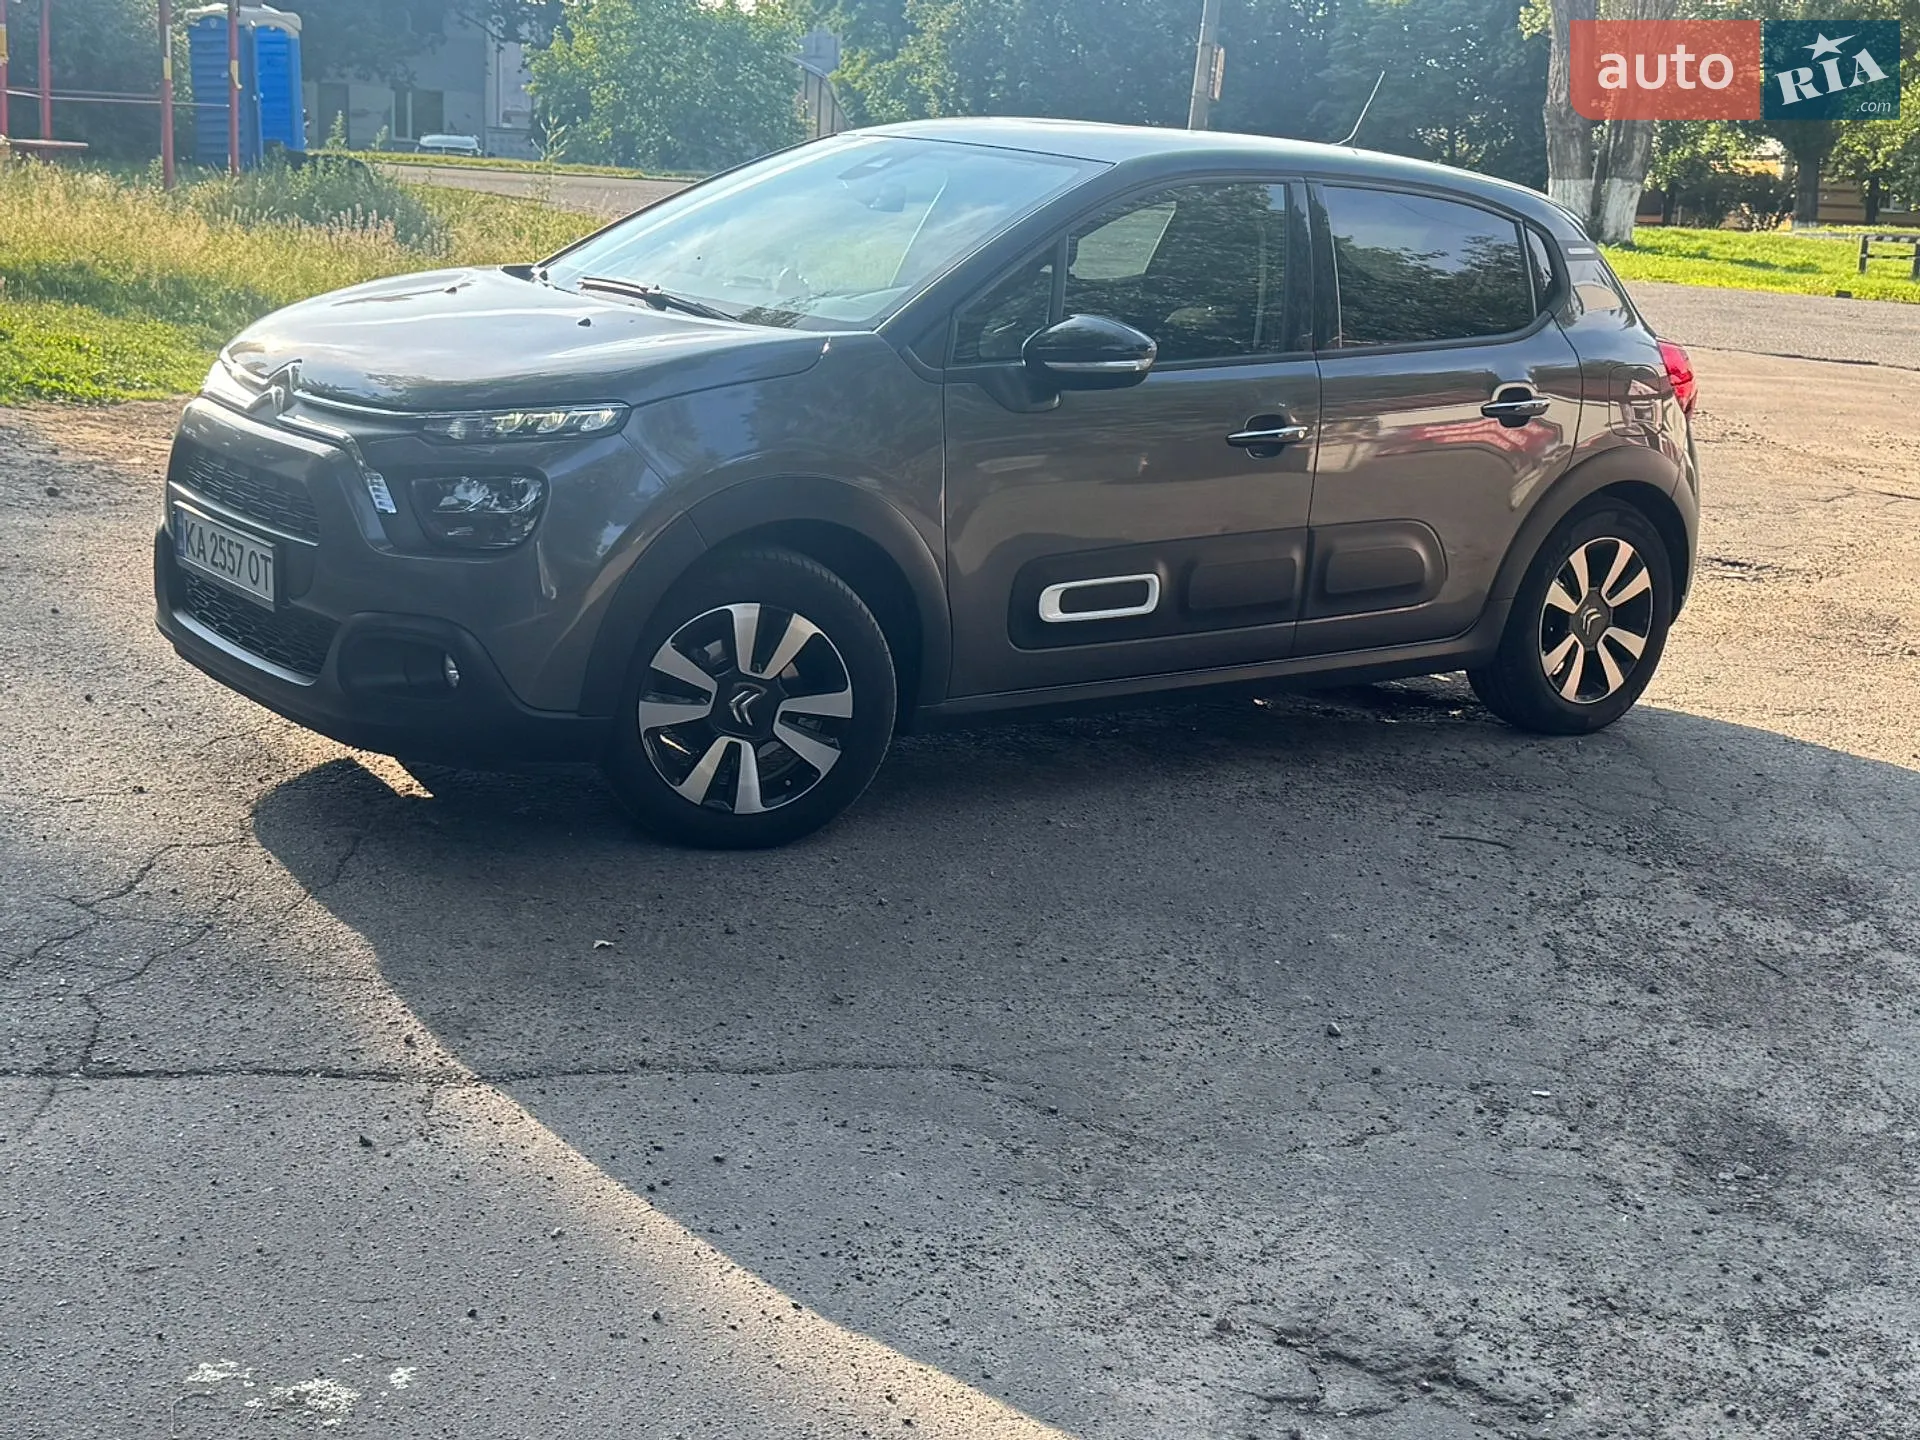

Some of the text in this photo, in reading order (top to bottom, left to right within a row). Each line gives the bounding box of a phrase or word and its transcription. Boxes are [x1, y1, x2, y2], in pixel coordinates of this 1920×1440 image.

[185, 519, 272, 592] KA 2557 OT
